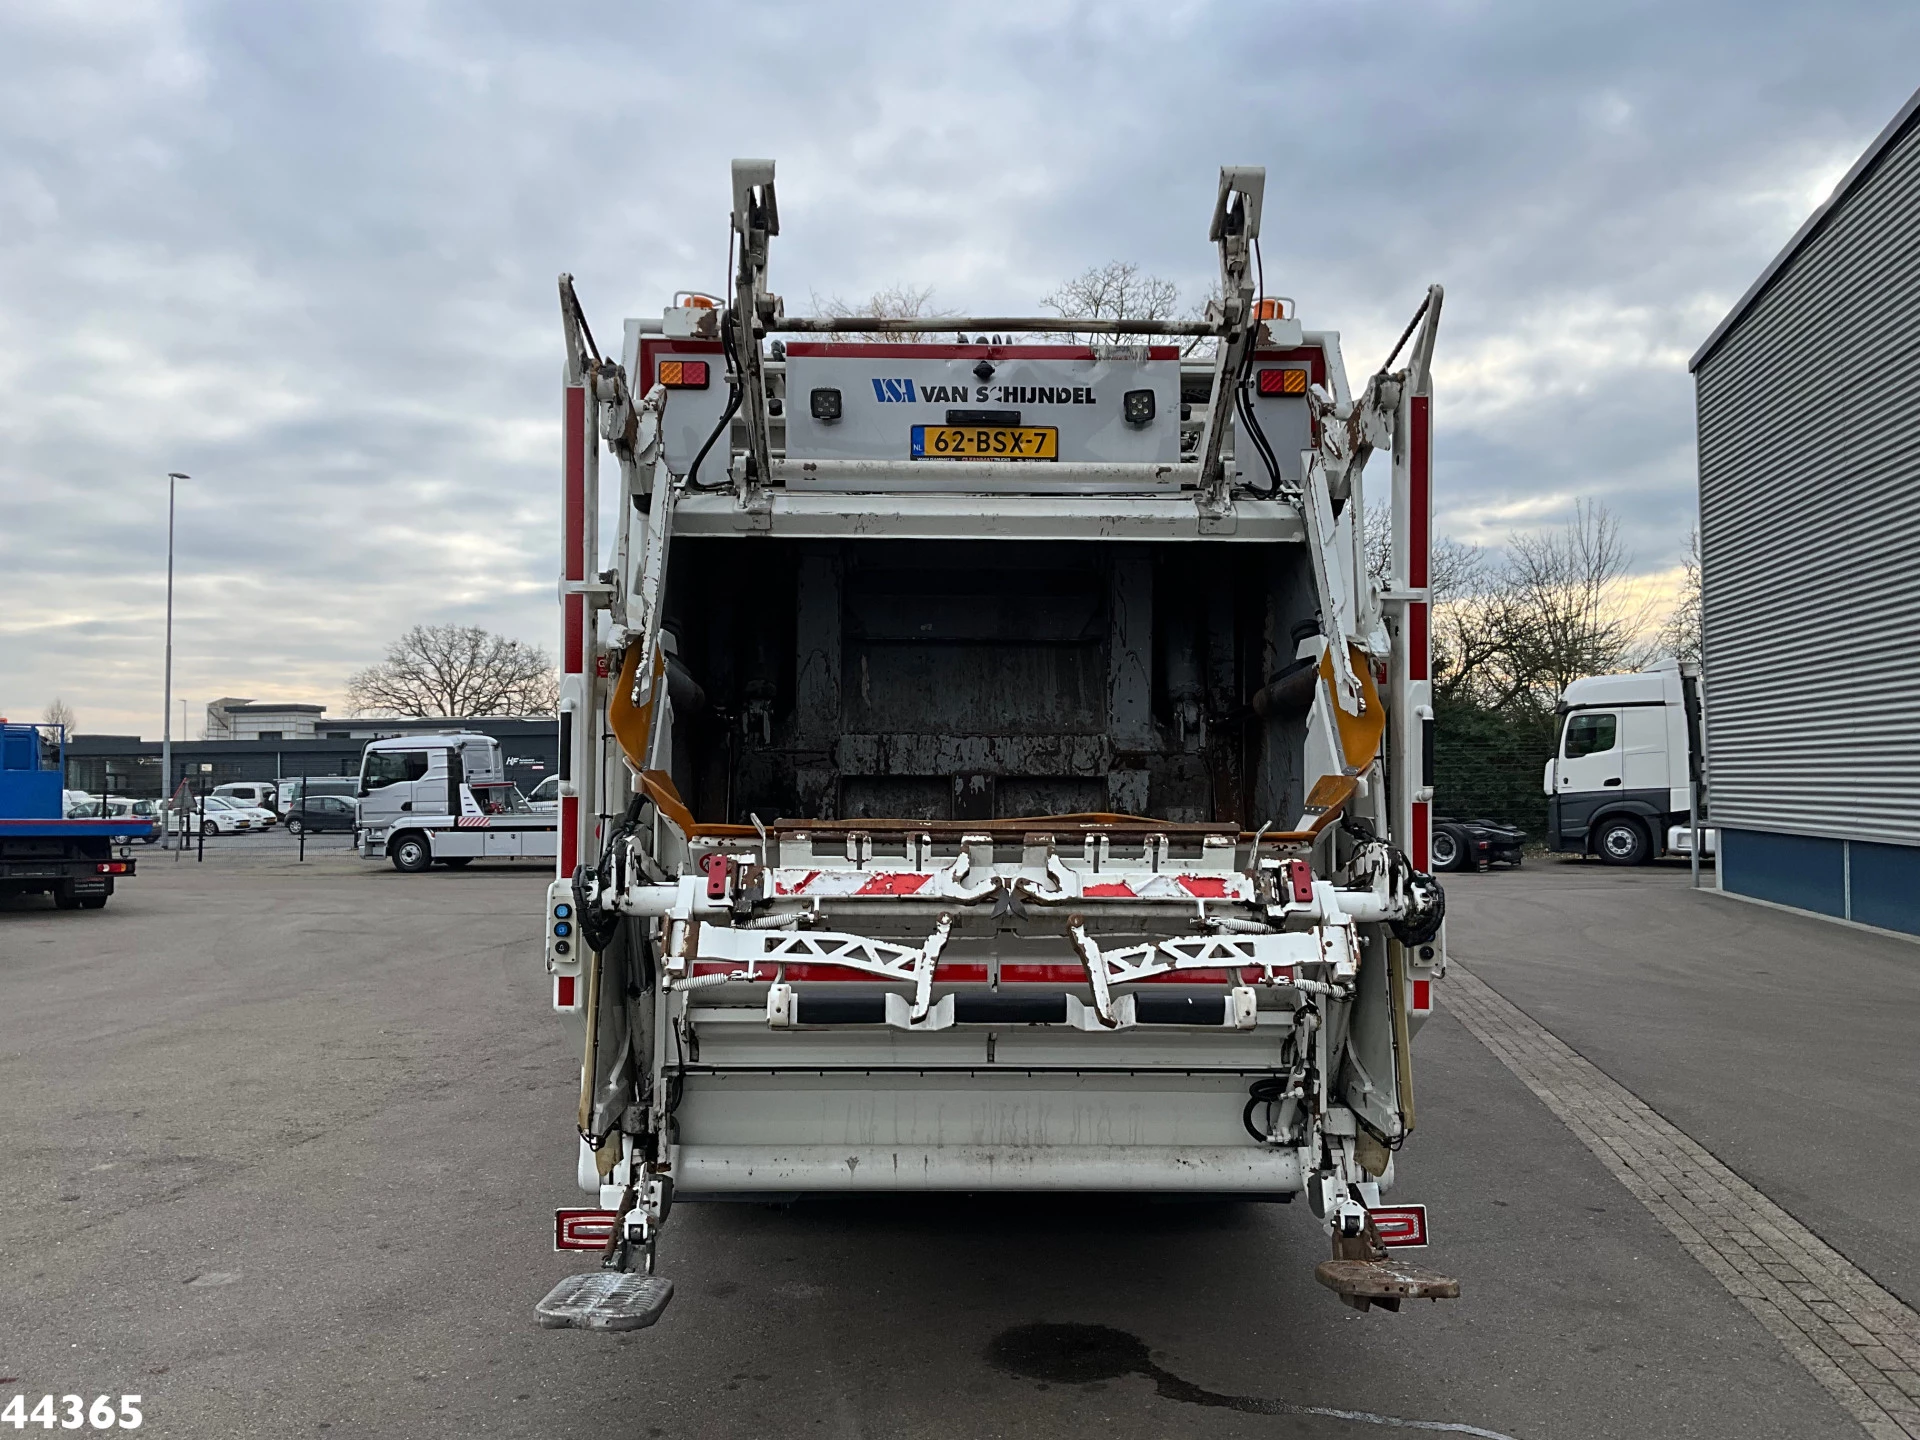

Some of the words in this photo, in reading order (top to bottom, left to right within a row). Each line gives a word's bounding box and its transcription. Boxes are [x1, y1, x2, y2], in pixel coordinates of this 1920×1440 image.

[920, 386, 968, 403] VAN
[913, 443, 923, 452] NL
[934, 430, 1048, 454] 62-BSX-7
